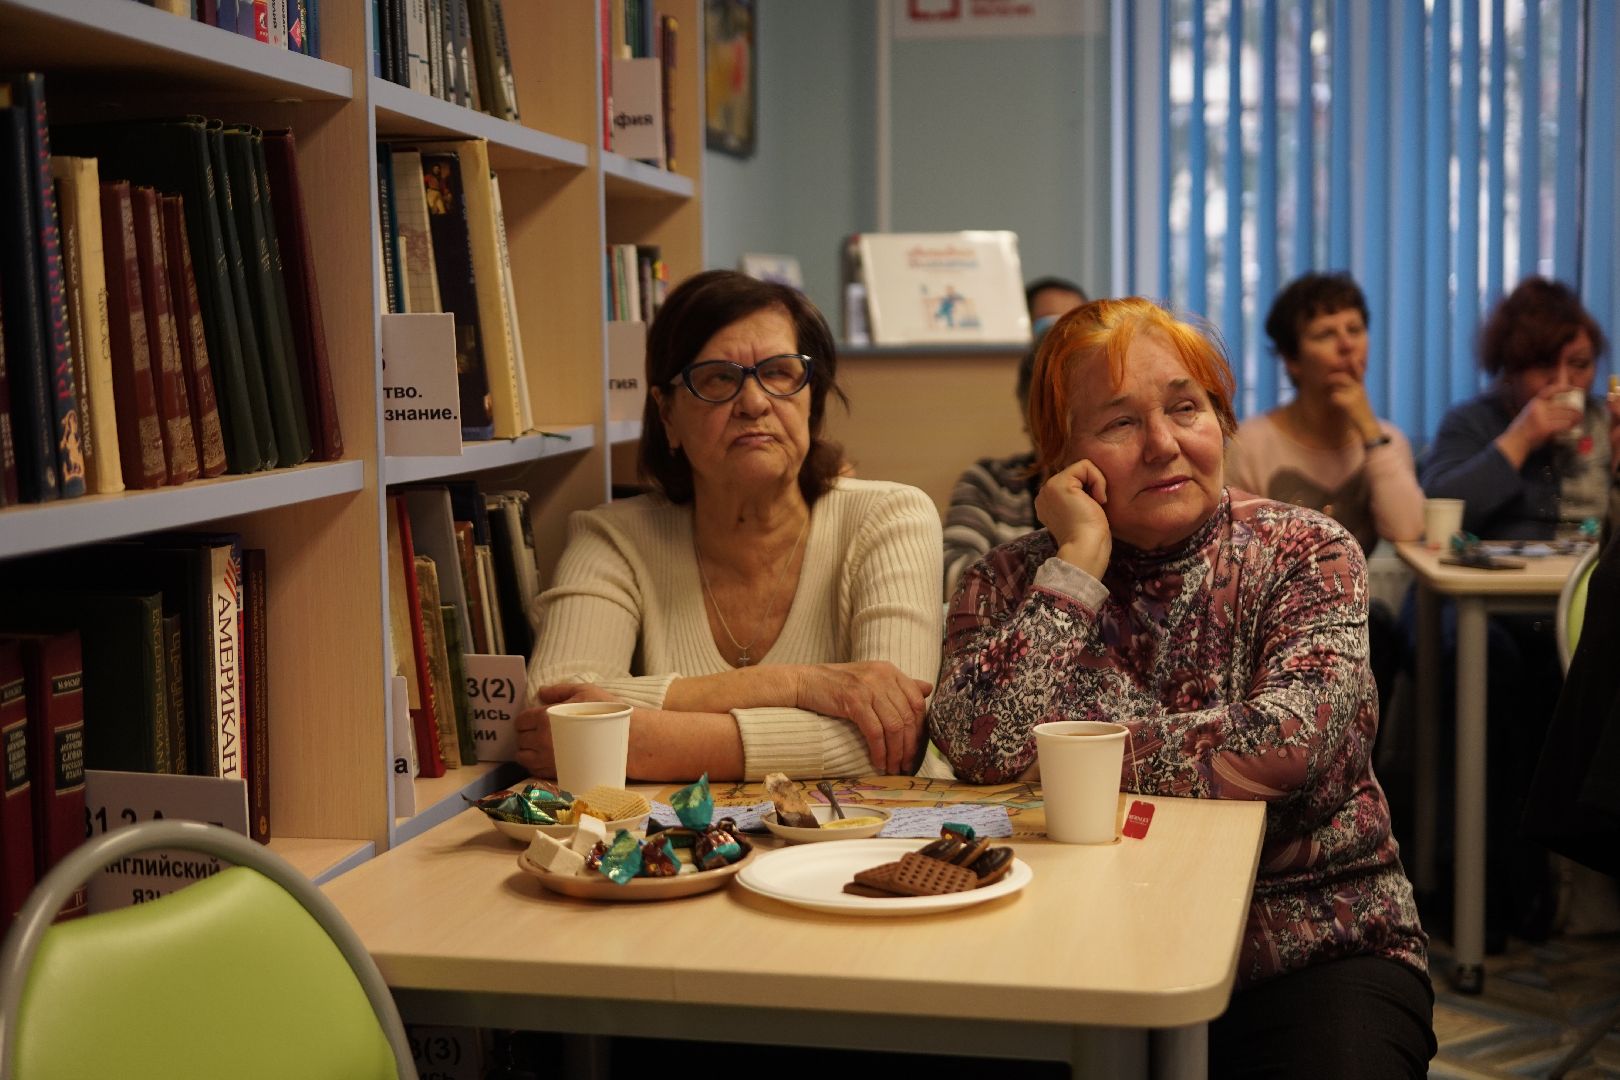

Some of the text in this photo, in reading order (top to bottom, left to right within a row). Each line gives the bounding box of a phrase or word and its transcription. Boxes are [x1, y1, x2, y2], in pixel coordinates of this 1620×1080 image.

[385, 408, 458, 421] знание.
[218, 593, 237, 779] АМЕРИКАН
[105, 854, 221, 879] нглийский
